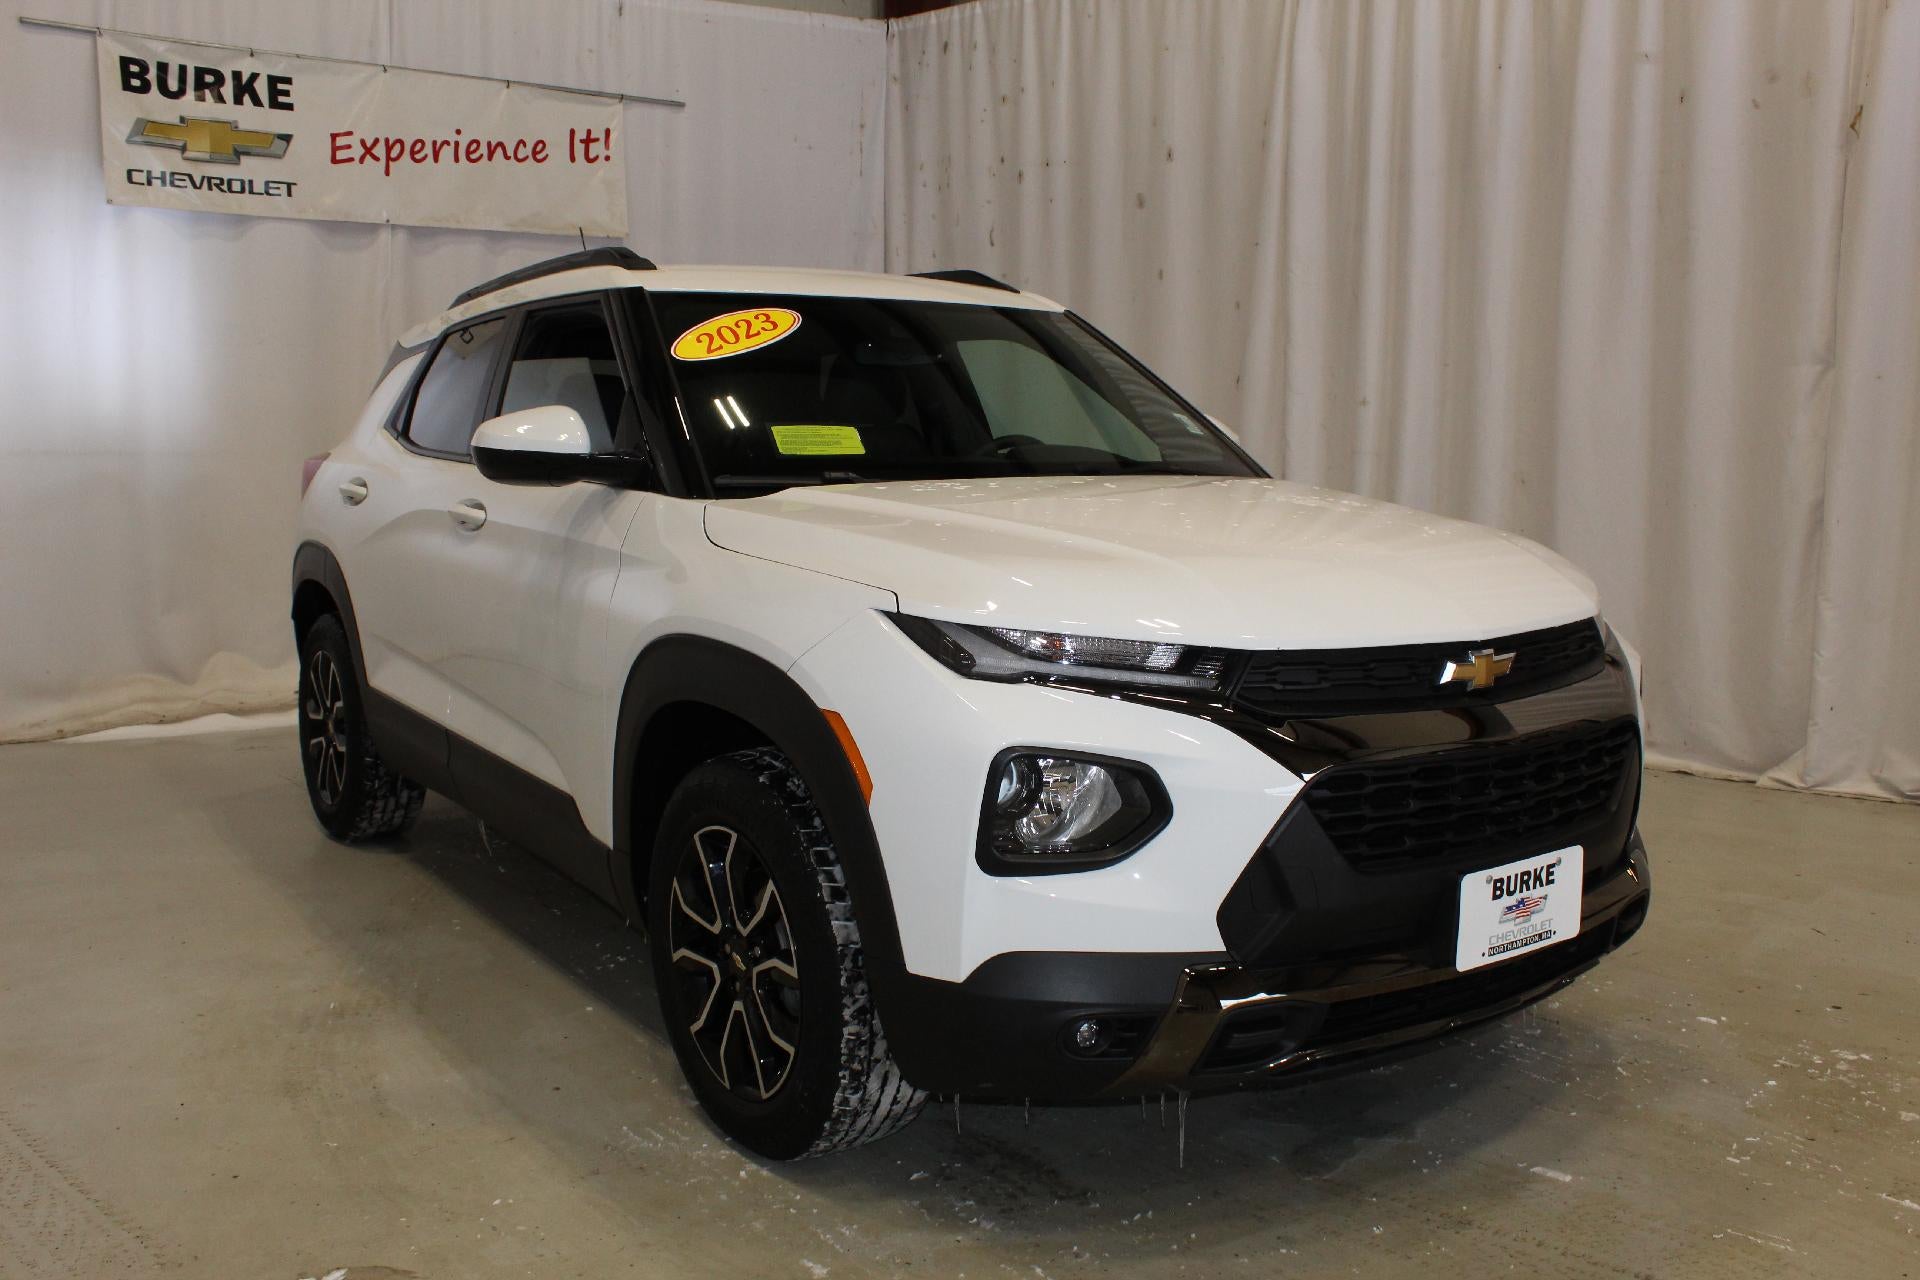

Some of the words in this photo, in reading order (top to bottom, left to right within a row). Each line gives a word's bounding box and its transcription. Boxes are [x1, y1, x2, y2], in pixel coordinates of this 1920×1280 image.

[119, 55, 295, 112] BURKE
[329, 128, 549, 177] Experience
[569, 127, 611, 164] It!
[126, 168, 298, 198] CHEVROLET
[696, 312, 779, 355] 2023
[1491, 862, 1557, 901] BURKE
[1488, 918, 1554, 946] CHEVROLET
[1540, 930, 1552, 941] MA
